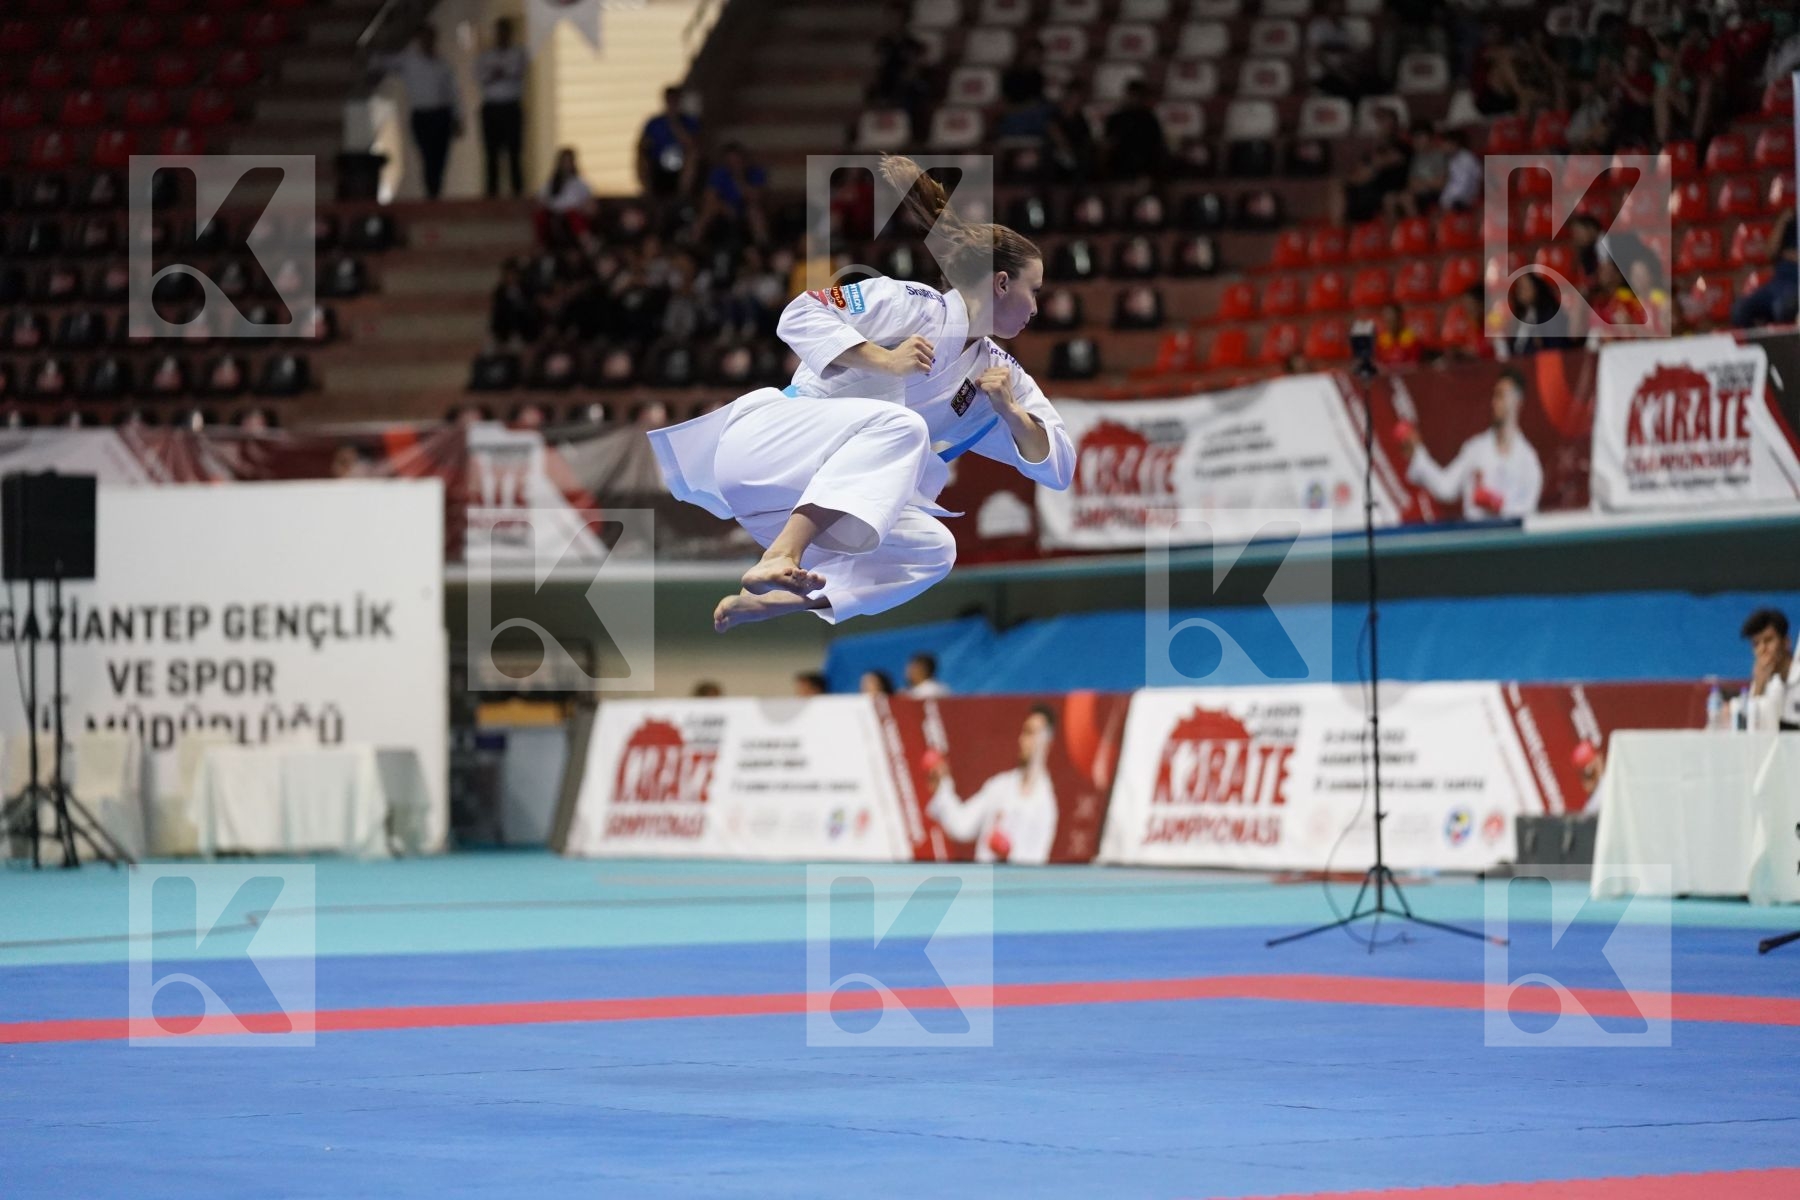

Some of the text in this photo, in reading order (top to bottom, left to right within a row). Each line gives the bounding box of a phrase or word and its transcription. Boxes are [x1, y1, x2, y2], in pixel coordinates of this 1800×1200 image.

[1626, 386, 1752, 447] KARATE
[222, 591, 396, 651] GENÇLİK
[107, 657, 277, 698] VE SPOR
[1151, 738, 1296, 805] KARATE
